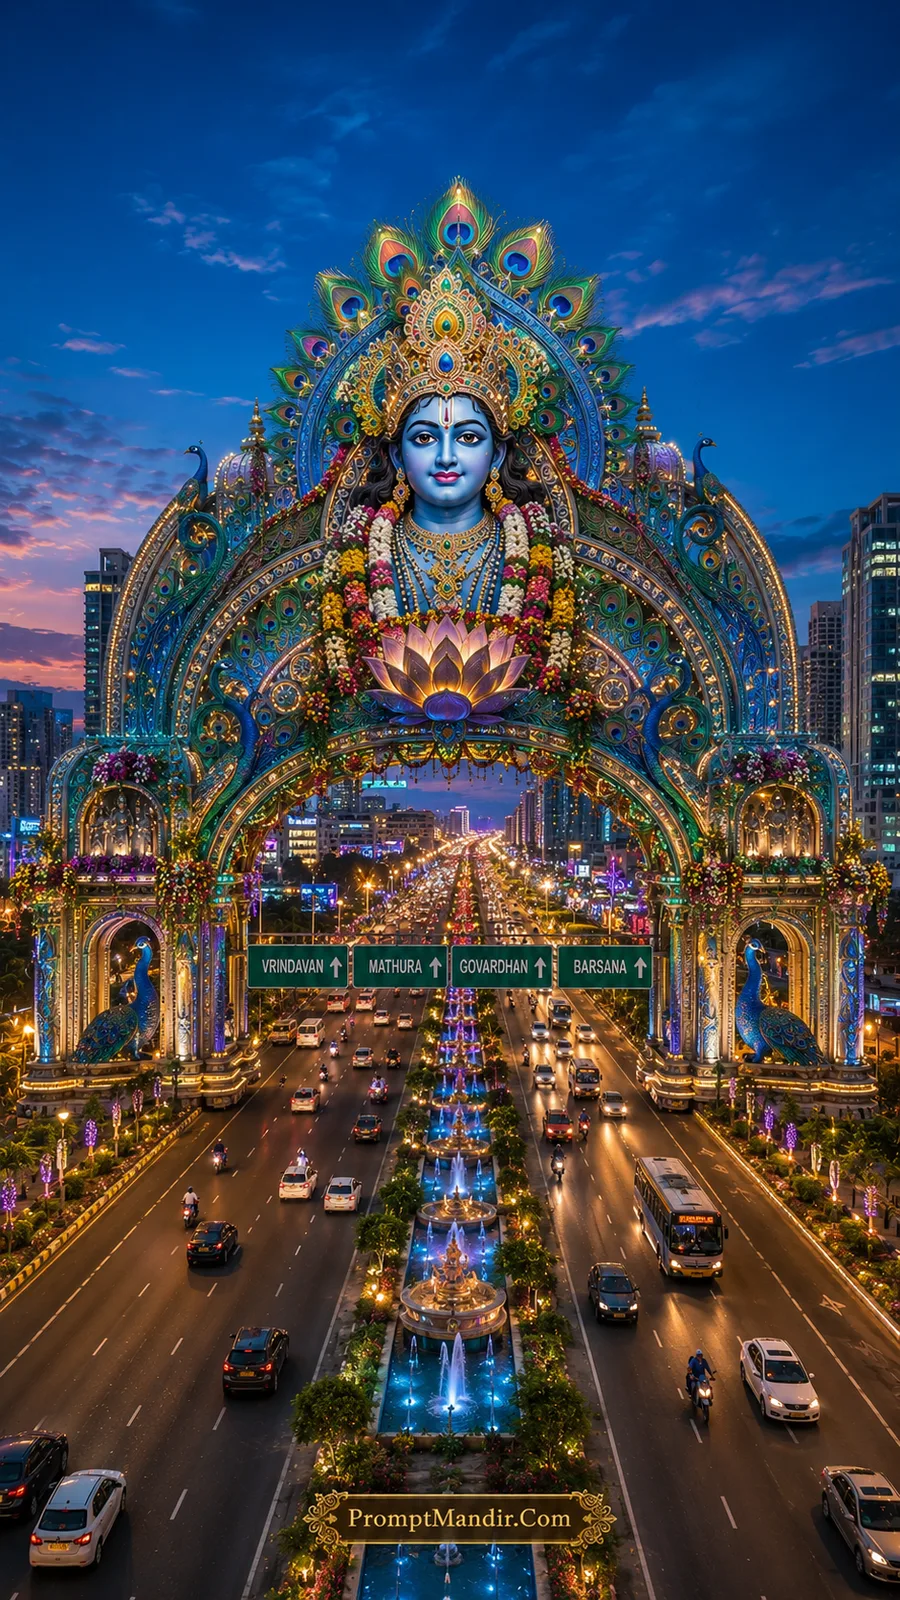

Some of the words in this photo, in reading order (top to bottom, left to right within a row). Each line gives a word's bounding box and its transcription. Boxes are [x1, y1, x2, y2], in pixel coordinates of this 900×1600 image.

[262, 959, 323, 974] VRINDAVAN
[369, 959, 422, 974] MATHURA
[460, 959, 528, 974] GOVARDHAN
[574, 960, 627, 974] BARSANA
